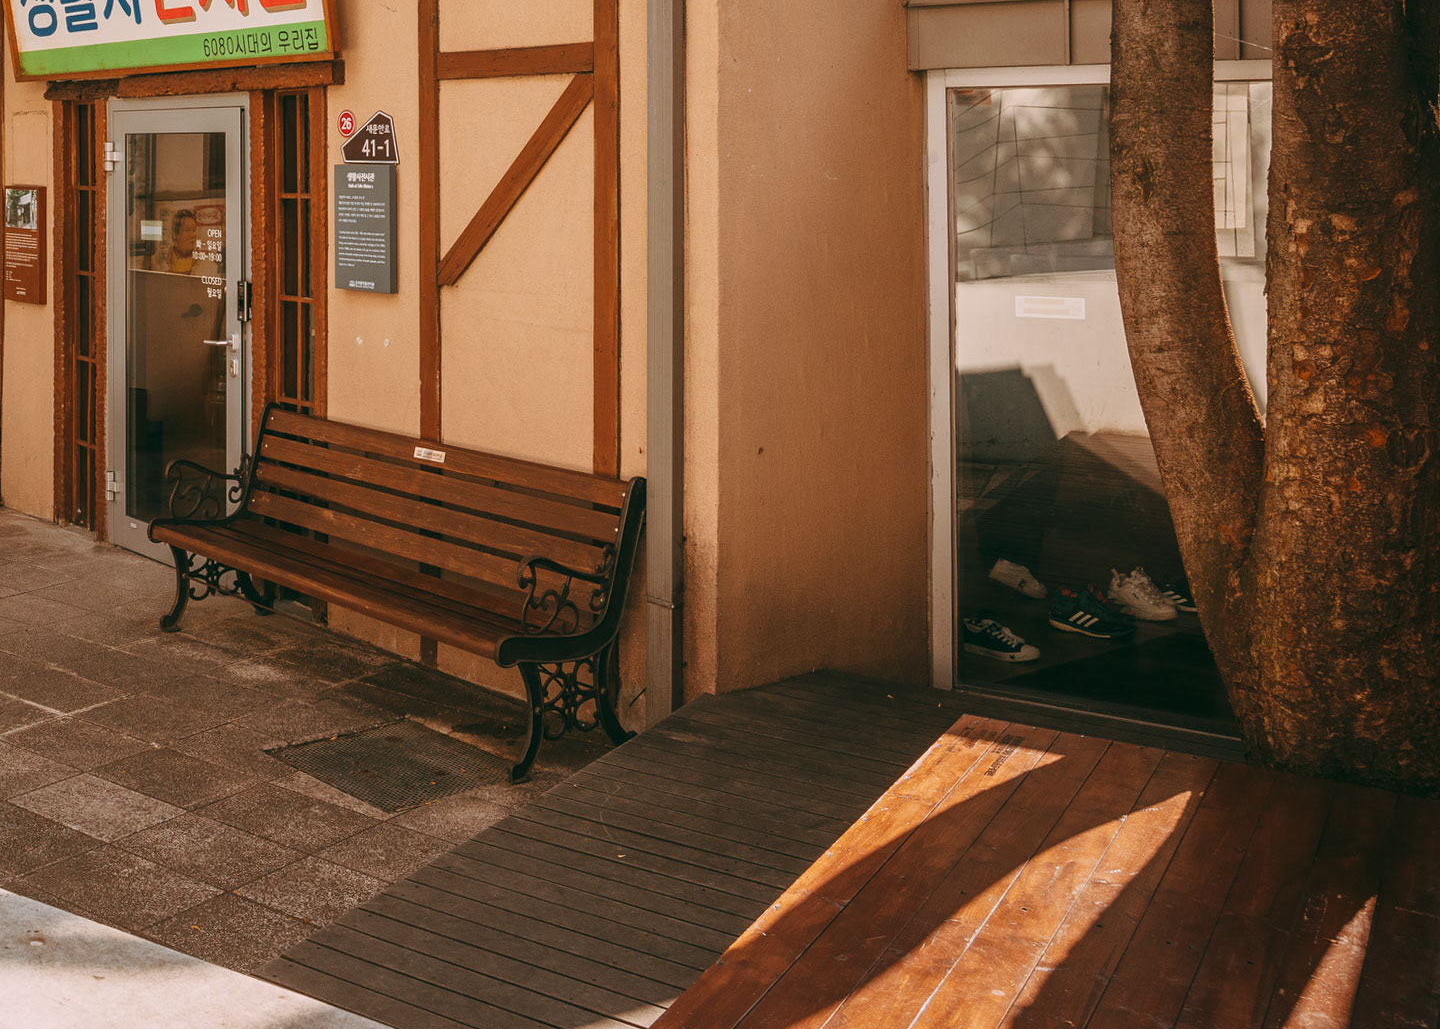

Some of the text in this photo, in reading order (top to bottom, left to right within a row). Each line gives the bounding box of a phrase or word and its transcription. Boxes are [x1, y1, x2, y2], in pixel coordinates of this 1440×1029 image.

[203, 27, 319, 58] 6080시대의 우리집
[341, 117, 352, 130] 26
[361, 138, 390, 157] 41-1
[207, 229, 222, 238] OPEN
[207, 240, 222, 252] 일요일
[201, 276, 222, 286] CLOSED
